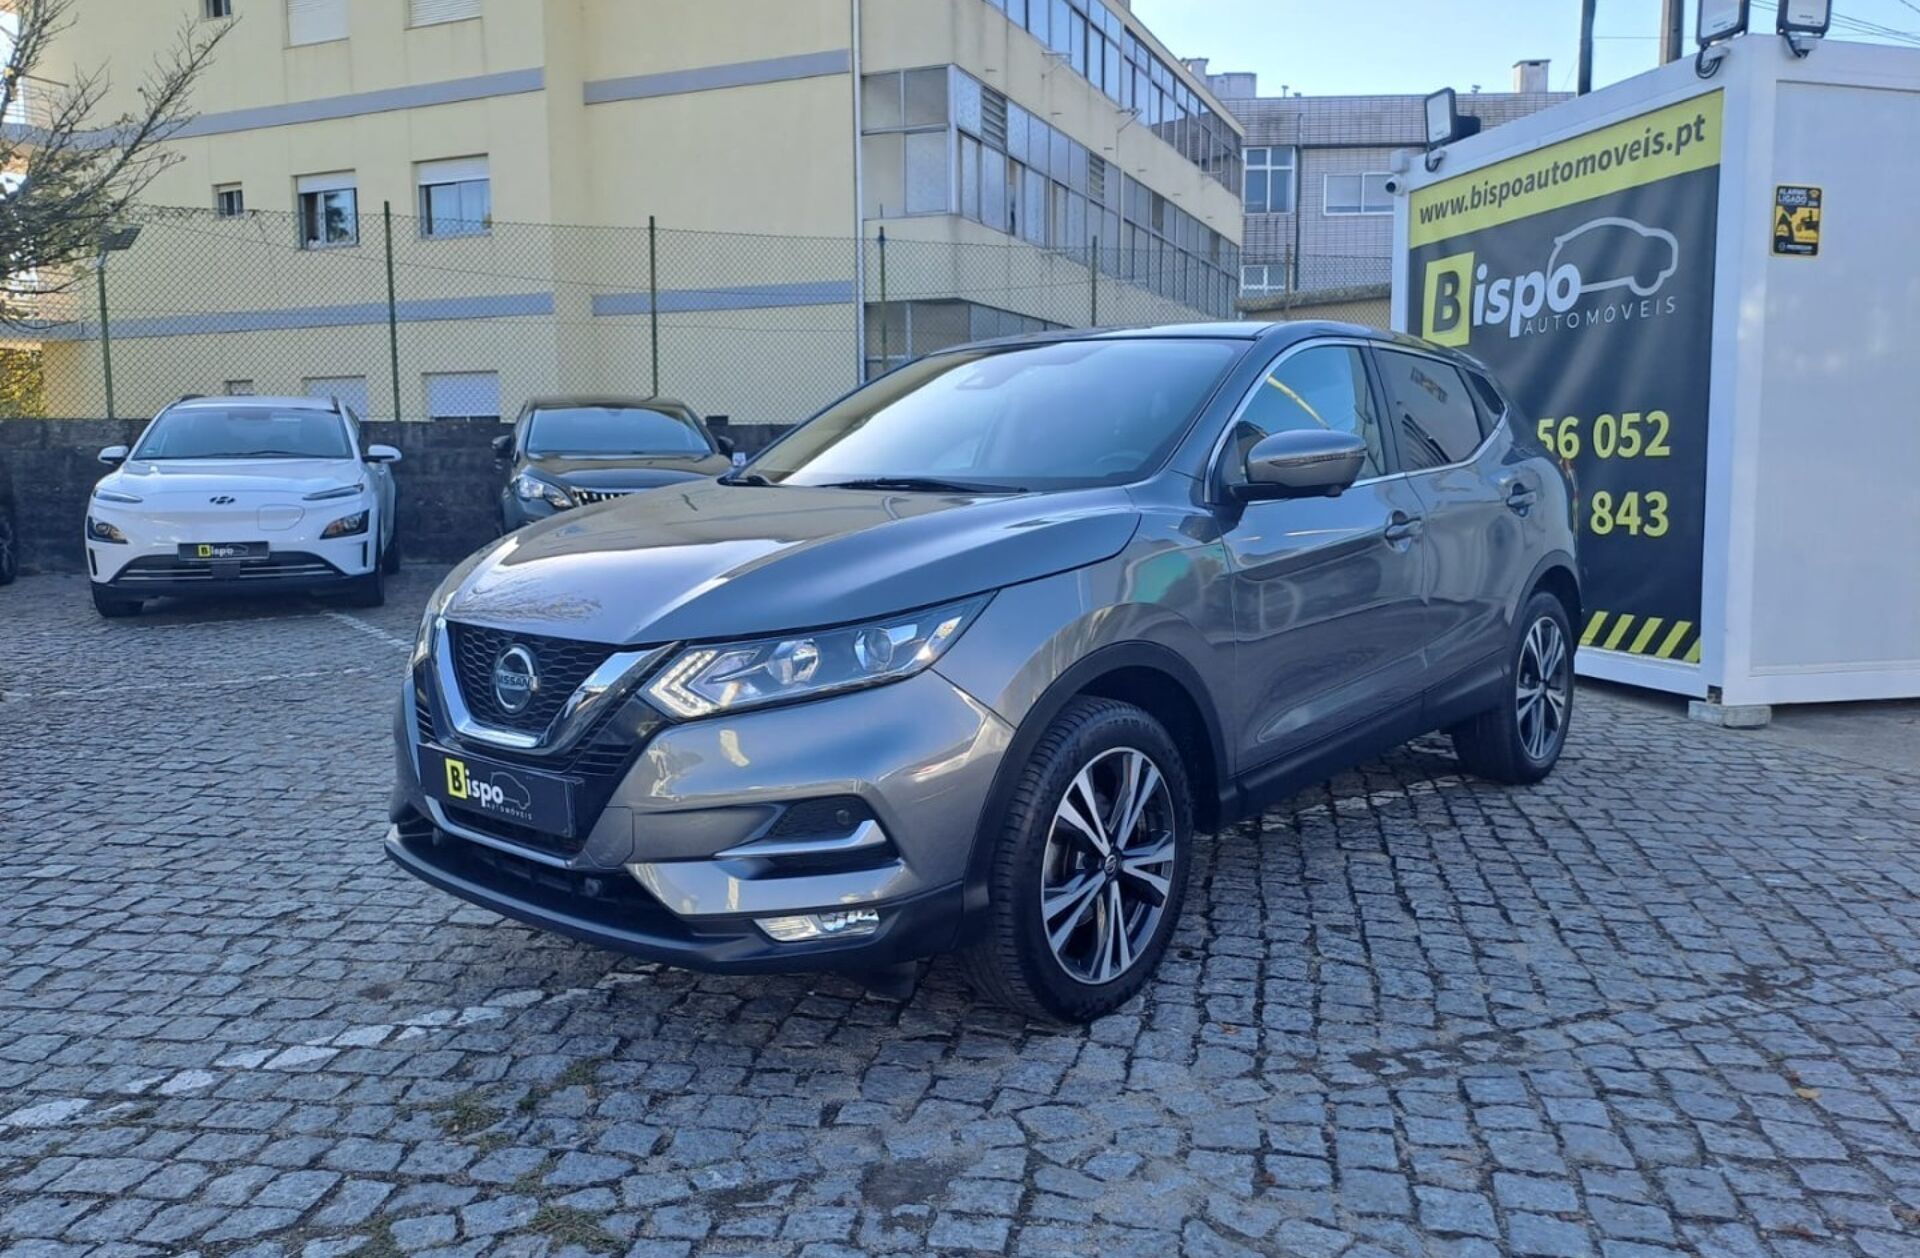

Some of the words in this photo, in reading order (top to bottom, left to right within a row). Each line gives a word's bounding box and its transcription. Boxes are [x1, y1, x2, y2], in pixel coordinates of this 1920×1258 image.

[1419, 114, 1706, 225] www.bispoautomoveis.pt
[1431, 262, 1582, 338] Bispo
[1592, 410, 1670, 459] 052
[1589, 490, 1669, 537] 843
[449, 764, 503, 808] Bispo
